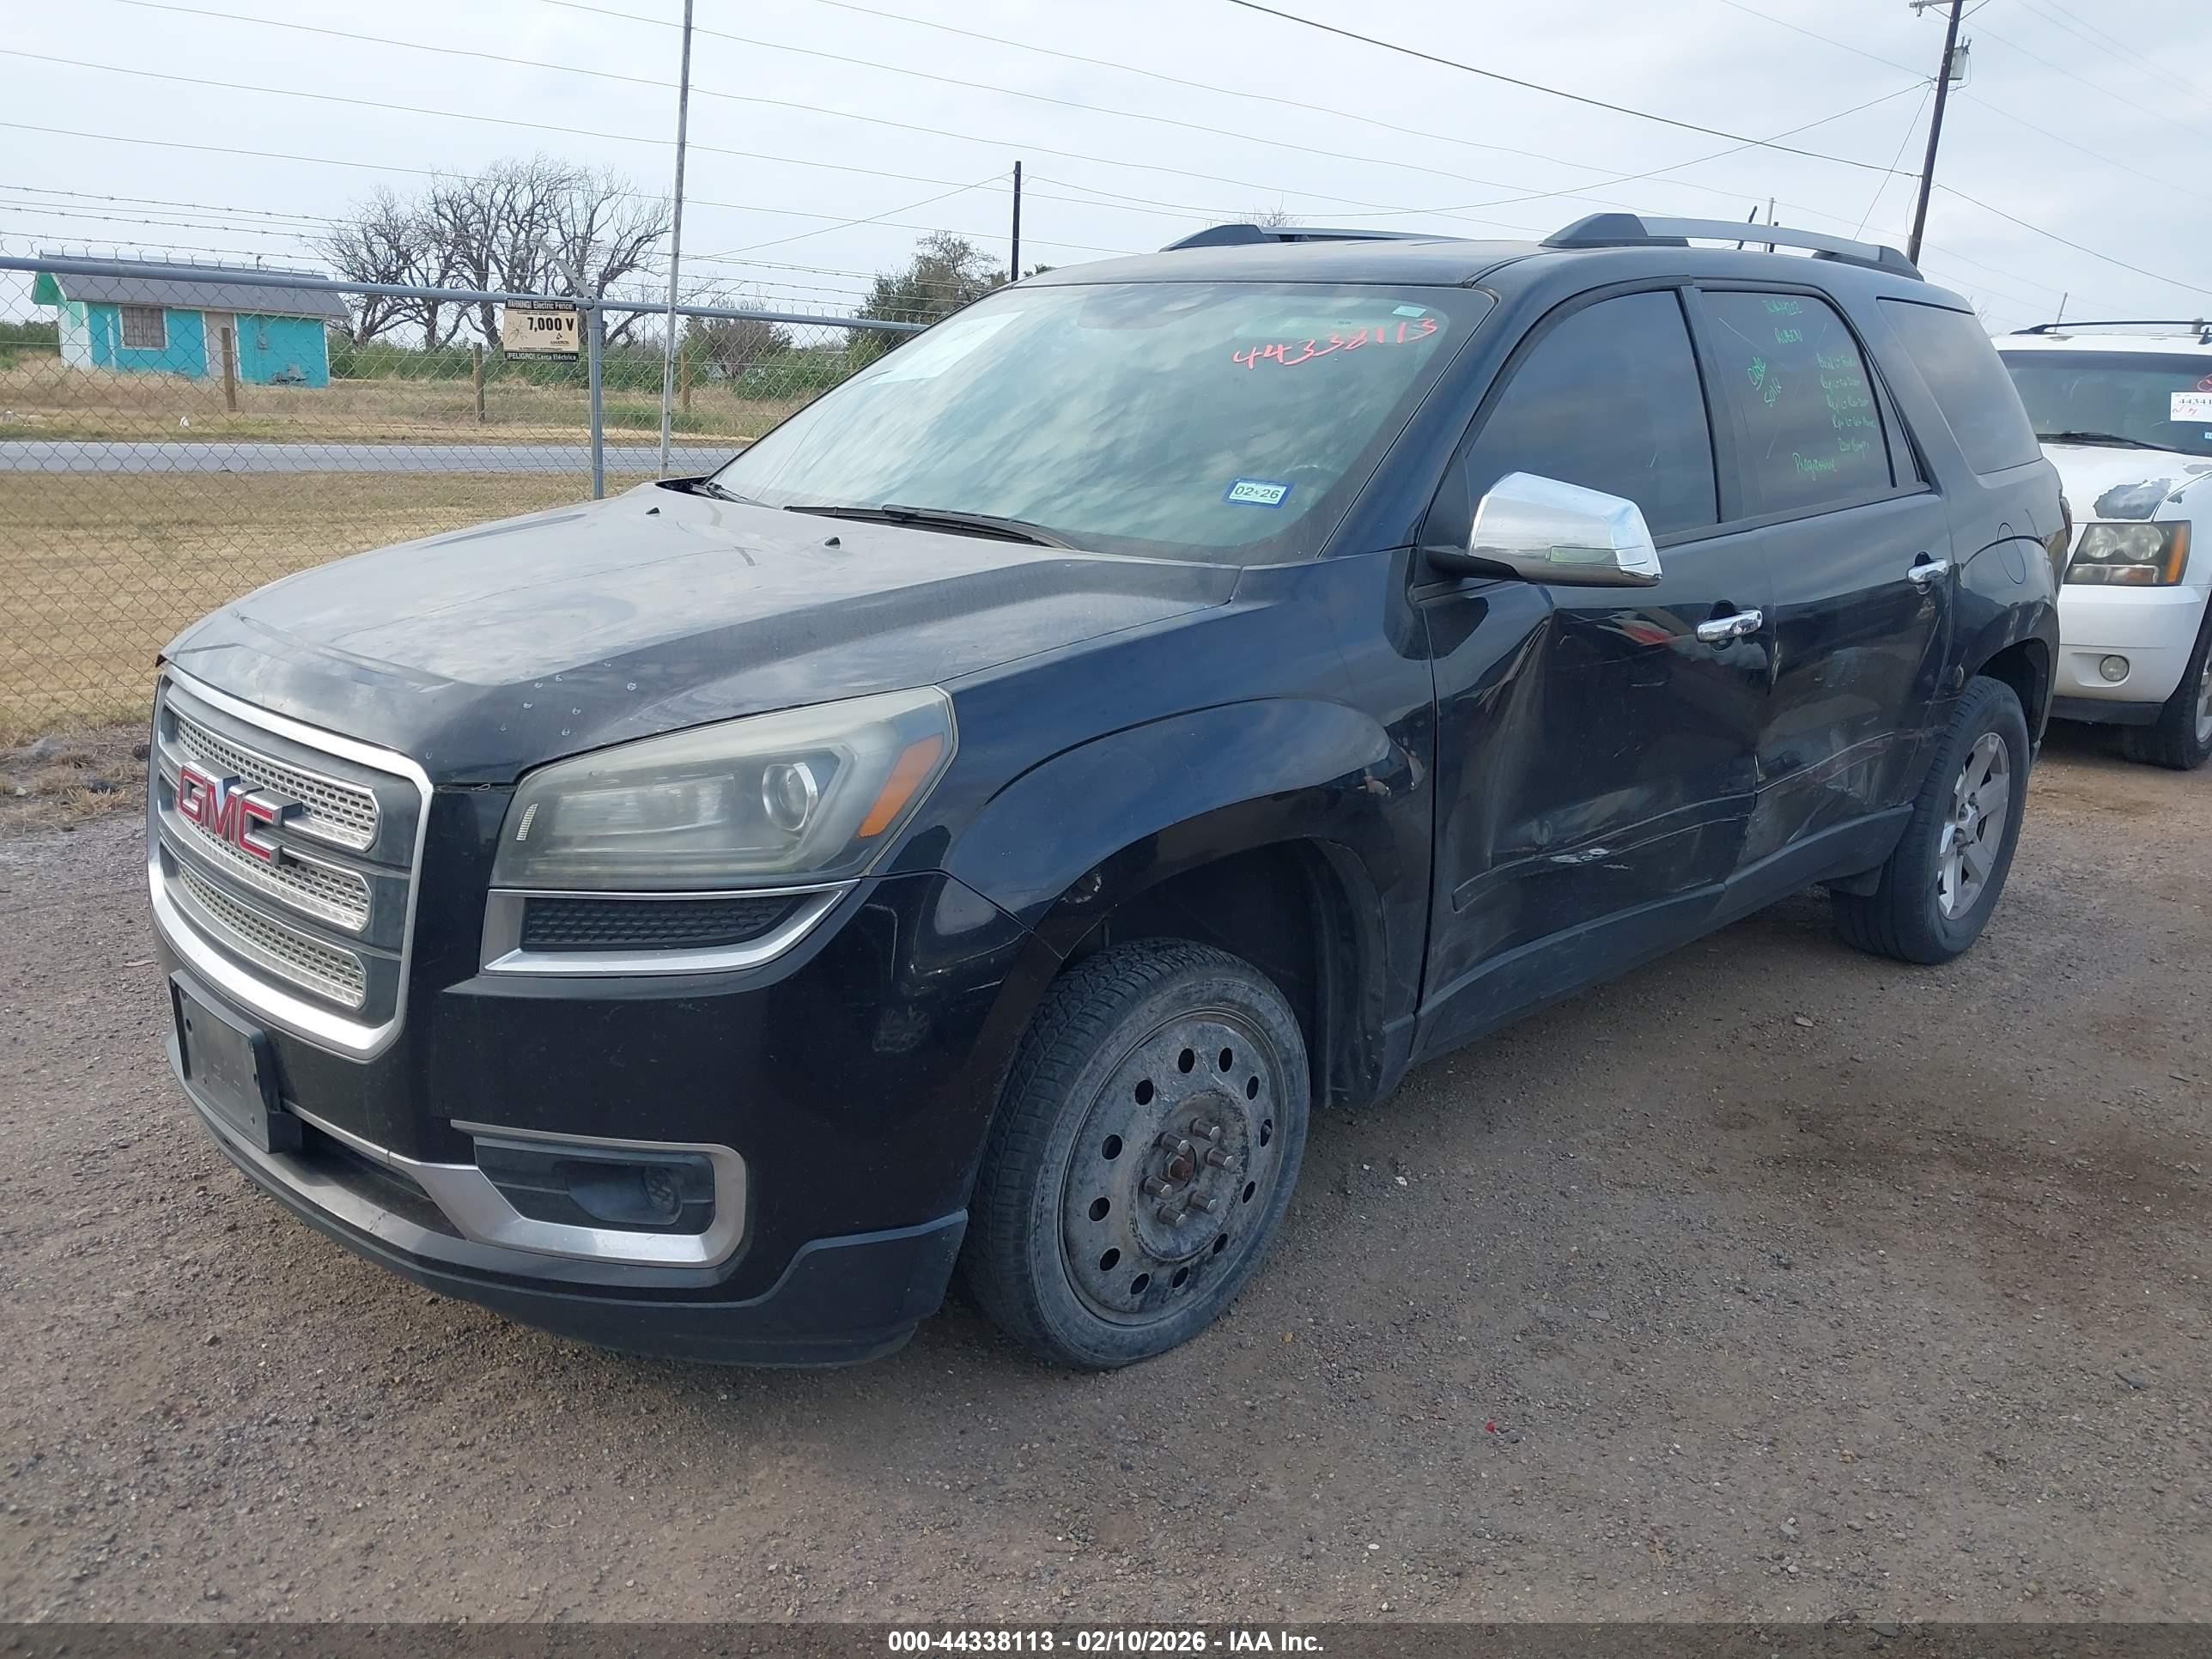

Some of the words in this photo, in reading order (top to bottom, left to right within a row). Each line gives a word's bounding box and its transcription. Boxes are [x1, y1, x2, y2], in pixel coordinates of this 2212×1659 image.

[533, 301, 555, 310] Electric
[527, 317, 562, 332] 7,000
[565, 318, 574, 331] V
[1233, 318, 1438, 370] 44338113
[179, 761, 285, 866] GMC
